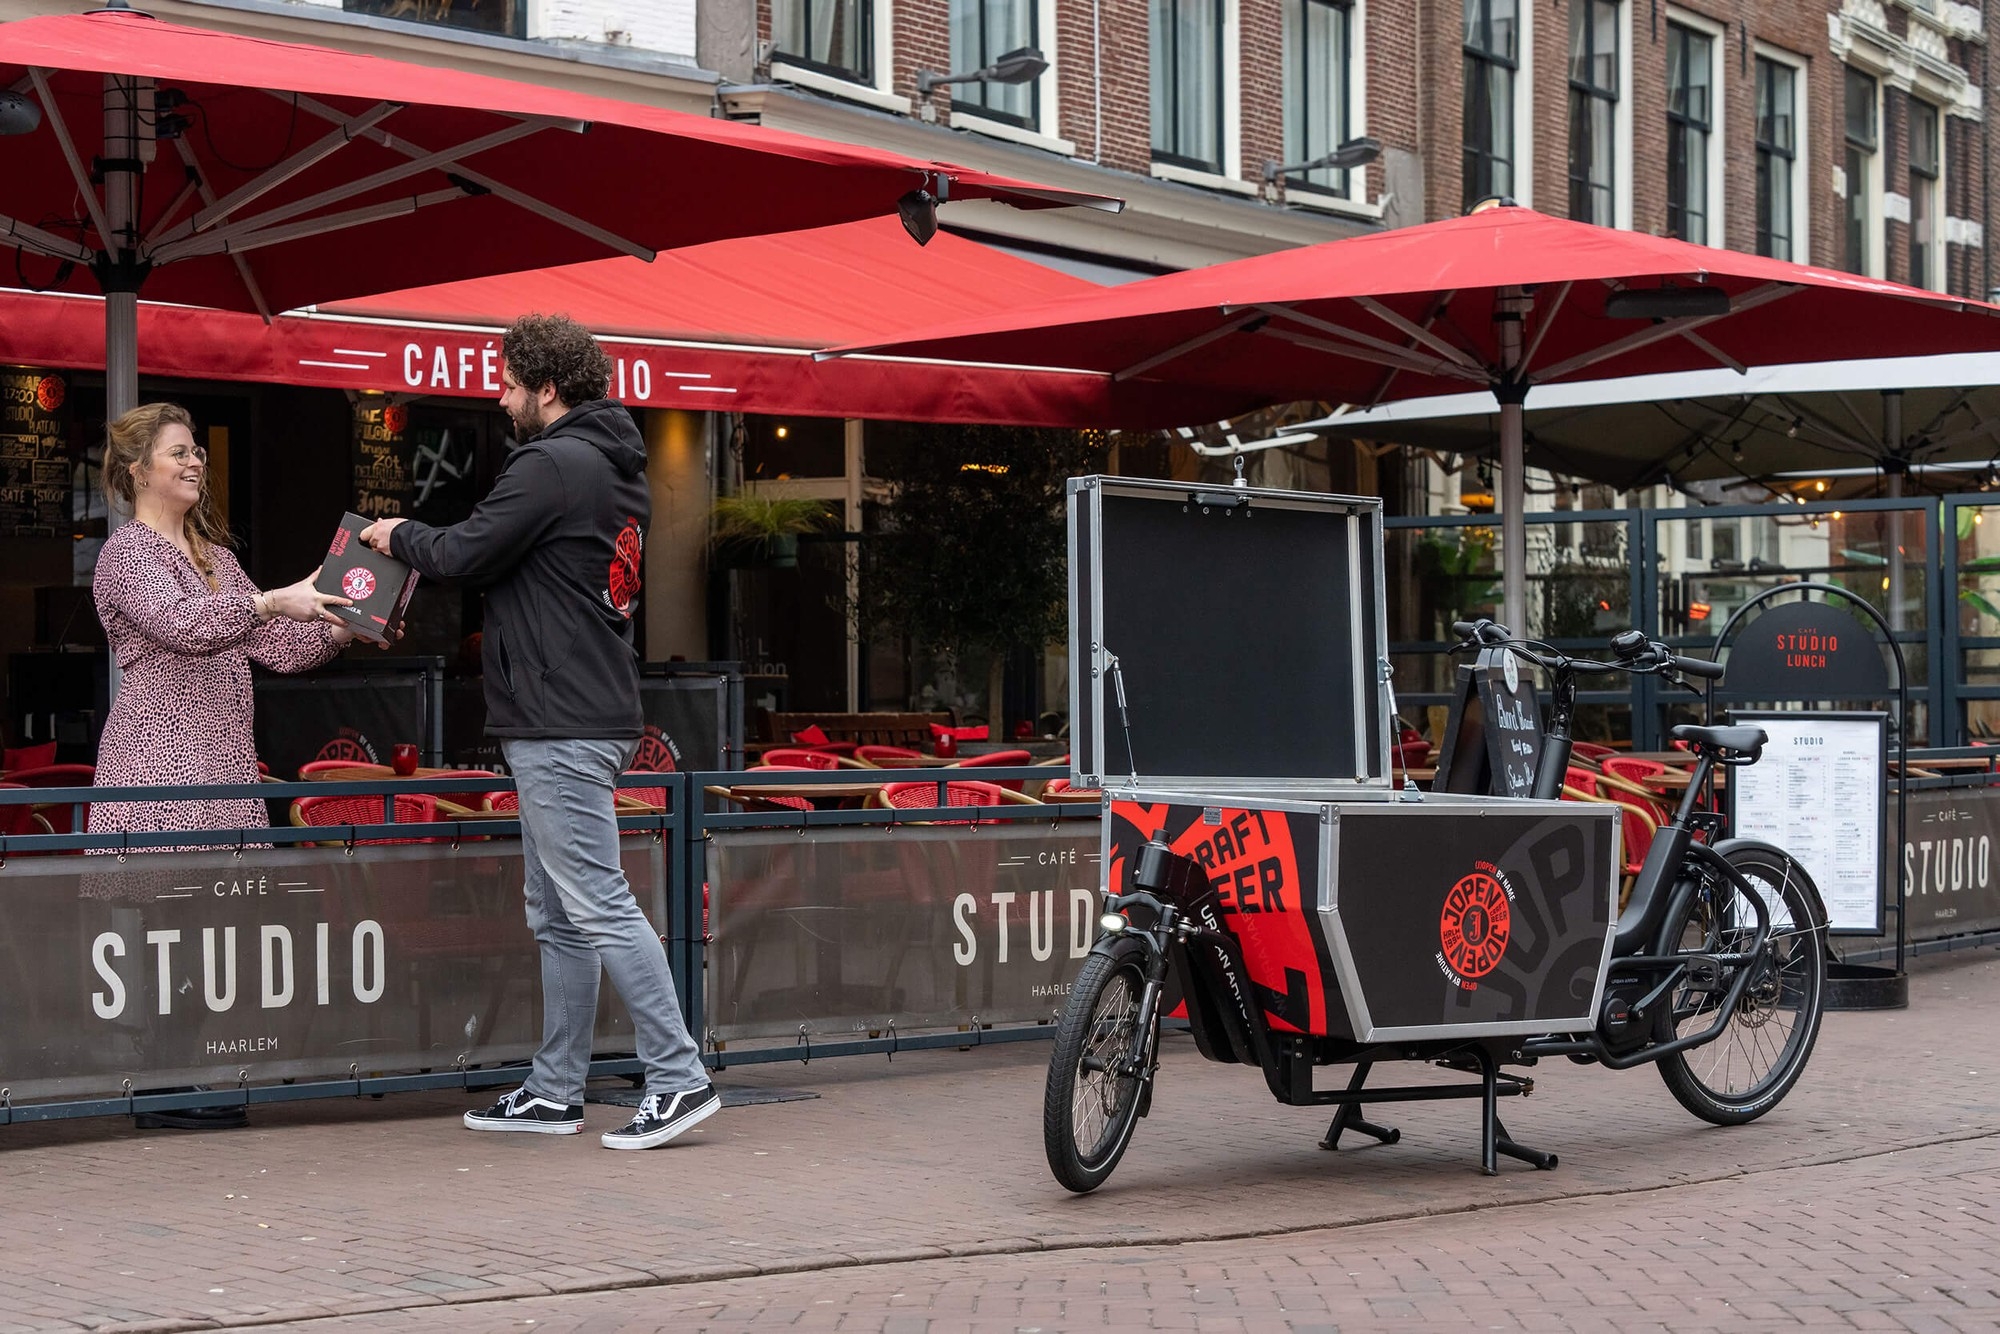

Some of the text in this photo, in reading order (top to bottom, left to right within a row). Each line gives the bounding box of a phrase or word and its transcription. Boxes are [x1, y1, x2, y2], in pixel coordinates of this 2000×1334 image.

[404, 341, 500, 391] CAFÉ
[5, 406, 34, 422] STUDIO
[345, 567, 375, 582] JOPEN
[343, 585, 373, 600] JOPEN
[1776, 634, 1839, 652] STUDIO
[1786, 654, 1827, 668] LUNCH
[1793, 736, 1824, 746] STUDIO
[1938, 808, 1957, 822] CAFÉ
[1038, 848, 1076, 865] CAFÉ
[1904, 835, 1990, 897] STUDIO
[214, 876, 268, 897] CAFÉ
[1210, 856, 1288, 915] EER
[1495, 869, 1505, 881] BY
[1502, 878, 1516, 902] NAME
[1444, 877, 1502, 926] JOPEN
[1490, 911, 1508, 923] BEER
[1934, 908, 1958, 919] HAARLEM
[953, 888, 1095, 966] STUD
[1449, 924, 1507, 974] JOPEN
[91, 919, 386, 1020] STUDIO
[1434, 951, 1478, 991] OPEN BY NATURE
[1032, 982, 1072, 997] HAARLE
[206, 1037, 279, 1054] HAARLEM
